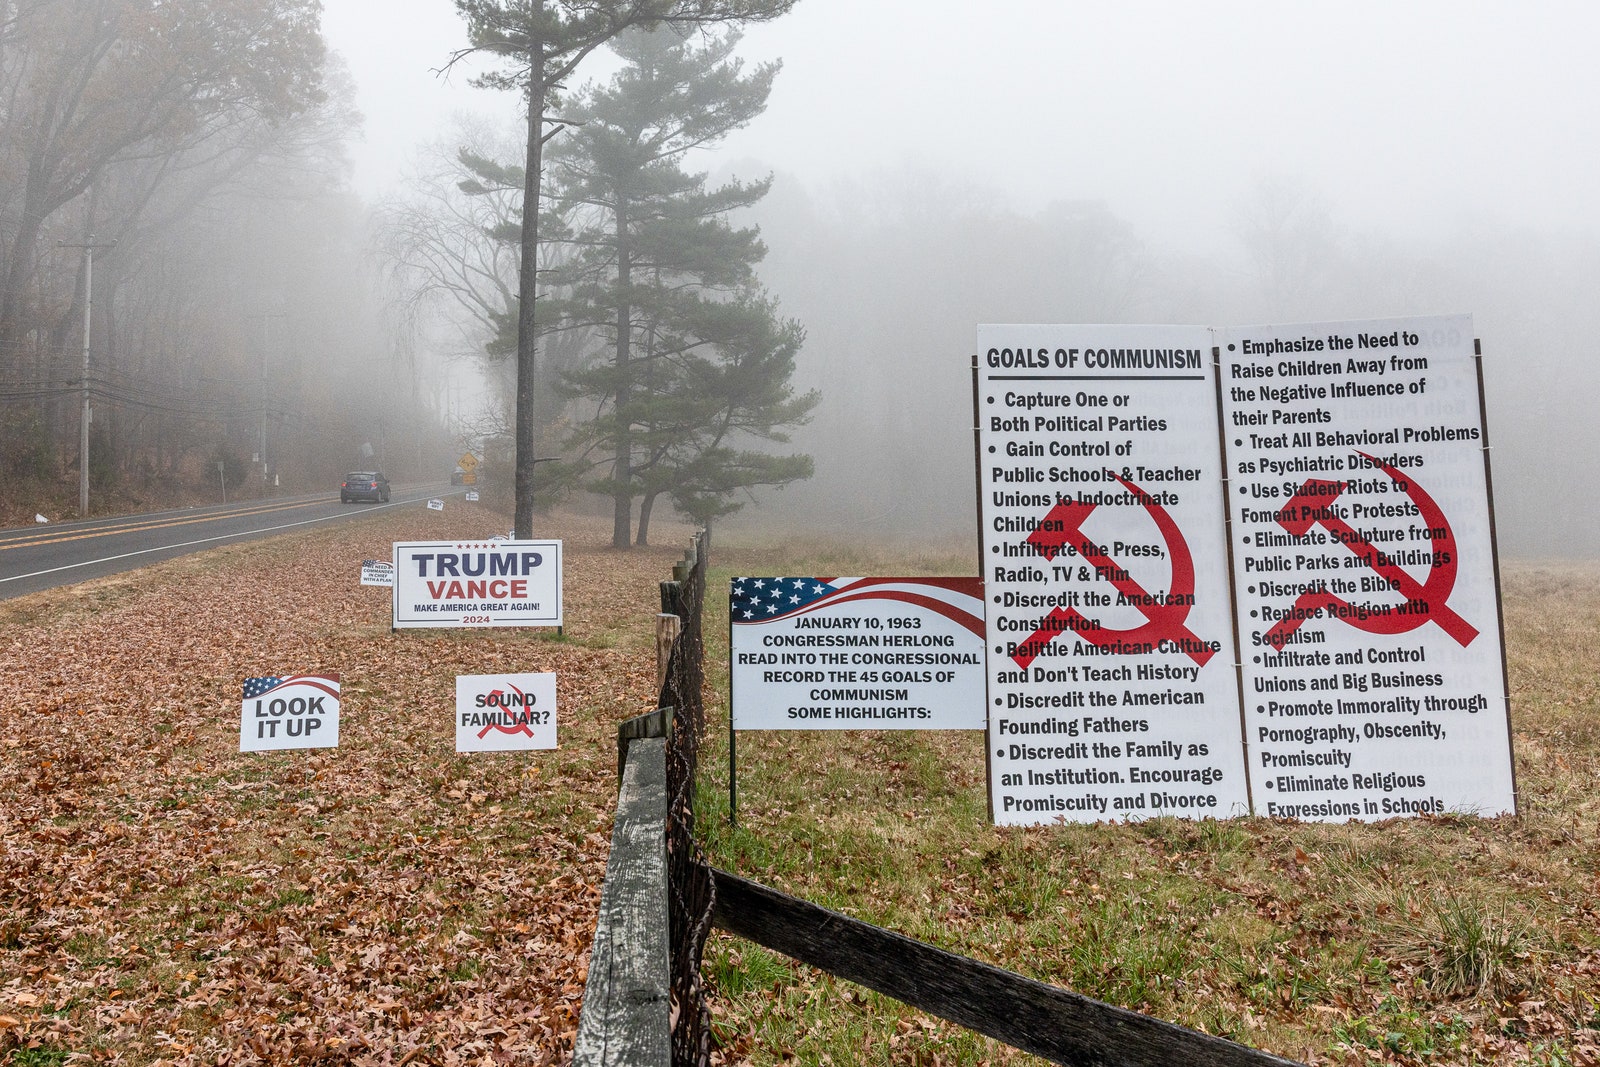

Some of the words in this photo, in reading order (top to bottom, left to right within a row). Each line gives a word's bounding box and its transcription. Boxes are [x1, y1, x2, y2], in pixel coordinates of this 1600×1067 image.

[1243, 337, 1324, 356] Emphasize
[1328, 335, 1353, 350] the
[1358, 332, 1398, 348] Need
[1402, 331, 1419, 345] to
[987, 348, 1049, 368] GOALS
[1055, 349, 1078, 368] OF
[1085, 349, 1201, 368] COMMUNISM
[1232, 363, 1273, 378] Raise
[1278, 361, 1341, 376] Children
[1347, 359, 1386, 375] Away
[1390, 356, 1427, 371] from
[1231, 387, 1255, 401] the
[1260, 384, 1326, 403] Negative
[1331, 382, 1404, 398] Influence
[1409, 378, 1425, 394] of
[1005, 392, 1070, 410] Capture
[1076, 392, 1108, 406] One
[1113, 395, 1129, 406] or
[991, 417, 1029, 431] Both
[1035, 416, 1102, 431] Political
[1108, 416, 1167, 431] Parties
[1233, 410, 1268, 425] their
[1272, 408, 1331, 424] Parents
[1250, 433, 1288, 448] Treat
[1293, 432, 1311, 447] All
[1316, 429, 1399, 446] Behavioral
[1404, 426, 1479, 442] Problems
[1007, 441, 1044, 456] Gain
[1050, 441, 1109, 456] Control
[1115, 441, 1132, 456] of
[1137, 466, 1201, 481] Teacher
[1239, 462, 1255, 473] as
[1260, 455, 1343, 476] Psychiatric
[1348, 453, 1424, 470] Disorders
[993, 467, 1044, 482] Public
[1119, 467, 1133, 483] &
[1252, 483, 1279, 498] Use
[1283, 479, 1343, 497] Student
[1347, 479, 1387, 494] Riots
[1391, 478, 1408, 492] to
[994, 491, 1051, 506] Unions
[1055, 491, 1073, 506] to
[1077, 490, 1179, 506] Indoctrinate
[1242, 507, 1297, 523] Foment
[1301, 504, 1348, 521] Public
[1353, 502, 1419, 518] Protests
[994, 516, 1063, 532] Children
[1255, 530, 1326, 547] Eliminate
[1330, 527, 1404, 546] Sculpture
[1409, 525, 1446, 540] from
[1004, 541, 1077, 557] Infiltrate
[1082, 541, 1108, 557] the
[1114, 542, 1164, 560] Press,
[412, 553, 542, 577] TRUMP
[1245, 556, 1291, 572] Public
[1296, 554, 1339, 570] Parks
[1344, 552, 1372, 568] and
[1376, 550, 1451, 568] Buildings
[995, 566, 1047, 585] Radio,
[1053, 567, 1072, 581] TV
[1078, 566, 1090, 581] &
[1095, 566, 1130, 581] Film
[426, 580, 528, 599] VANCE
[1259, 579, 1328, 597] Discredit
[1331, 579, 1356, 593] the
[1361, 576, 1400, 592] Bible
[1004, 591, 1079, 608] Discredit
[1083, 591, 1110, 606] the
[1116, 590, 1195, 606] American
[463, 616, 490, 624] 2024
[1262, 605, 1323, 624] Replace
[1328, 601, 1391, 620] Religion
[1395, 599, 1429, 615] with
[795, 618, 861, 628] JANUARY
[864, 618, 883, 630] 10,
[887, 618, 921, 628] 1963
[997, 615, 1101, 631] Constitution
[763, 635, 879, 646] CONGRESSMAN
[883, 636, 954, 646] HERLONG
[1252, 628, 1325, 646] Socialism
[1007, 641, 1068, 658] Belittle
[1073, 640, 1152, 656] American
[1158, 638, 1221, 654] Culture
[1264, 651, 1330, 667] Infiltrate
[1335, 649, 1363, 665] and
[1368, 646, 1425, 663] Control
[739, 654, 777, 664] READ
[782, 653, 816, 664] INTO
[819, 654, 848, 664] THE
[852, 653, 980, 664] CONGRESSIONAL
[764, 671, 825, 682] RECORD
[828, 672, 856, 682] THE
[860, 672, 878, 682] 45
[882, 671, 932, 682] GOALS
[936, 671, 955, 682] OF
[998, 668, 1028, 683] and
[1034, 667, 1078, 682] Don't
[1082, 666, 1131, 681] Teach
[1137, 664, 1199, 682] History
[1255, 676, 1306, 692] Unions
[1311, 675, 1338, 690] and
[1343, 673, 1368, 692] Big
[1372, 672, 1443, 688] Business
[476, 694, 536, 707] SOUND
[810, 689, 907, 700] COMMUNISM
[1008, 691, 1084, 708] Discredit
[1089, 691, 1117, 706] the
[1123, 689, 1204, 705] American
[256, 697, 325, 717] LOOK
[788, 707, 831, 718] SOME
[835, 707, 931, 718] HIGHLIGHTS:
[1269, 700, 1333, 716] Promote
[1337, 697, 1420, 715] Immorality
[1424, 694, 1487, 713] through
[258, 720, 280, 738] IT
[287, 718, 321, 736] UP
[462, 711, 550, 726] FAMILIAR?
[1000, 718, 1078, 736] Founding
[1084, 717, 1148, 732] Fathers
[1259, 724, 1359, 744] Pornography,
[1364, 721, 1445, 739] Obscenity,
[1010, 743, 1088, 760] Discredit
[1092, 743, 1121, 758] the
[1126, 741, 1182, 760] Family
[1188, 744, 1208, 756] as
[1262, 749, 1351, 768] Promiscuity
[1002, 774, 1022, 786] an
[1028, 768, 1124, 785] Institution.
[1130, 767, 1222, 785] Encourage
[1277, 775, 1348, 792] Eliminate
[1353, 772, 1425, 791] Religious
[1004, 794, 1107, 813] Promiscuity
[1114, 793, 1145, 809] and
[1151, 792, 1216, 808] Divorce
[1268, 802, 1360, 817] Expressions
[1364, 799, 1378, 814] in
[1382, 797, 1444, 813] Schools
[1382, 797, 1444, 813] Schools
